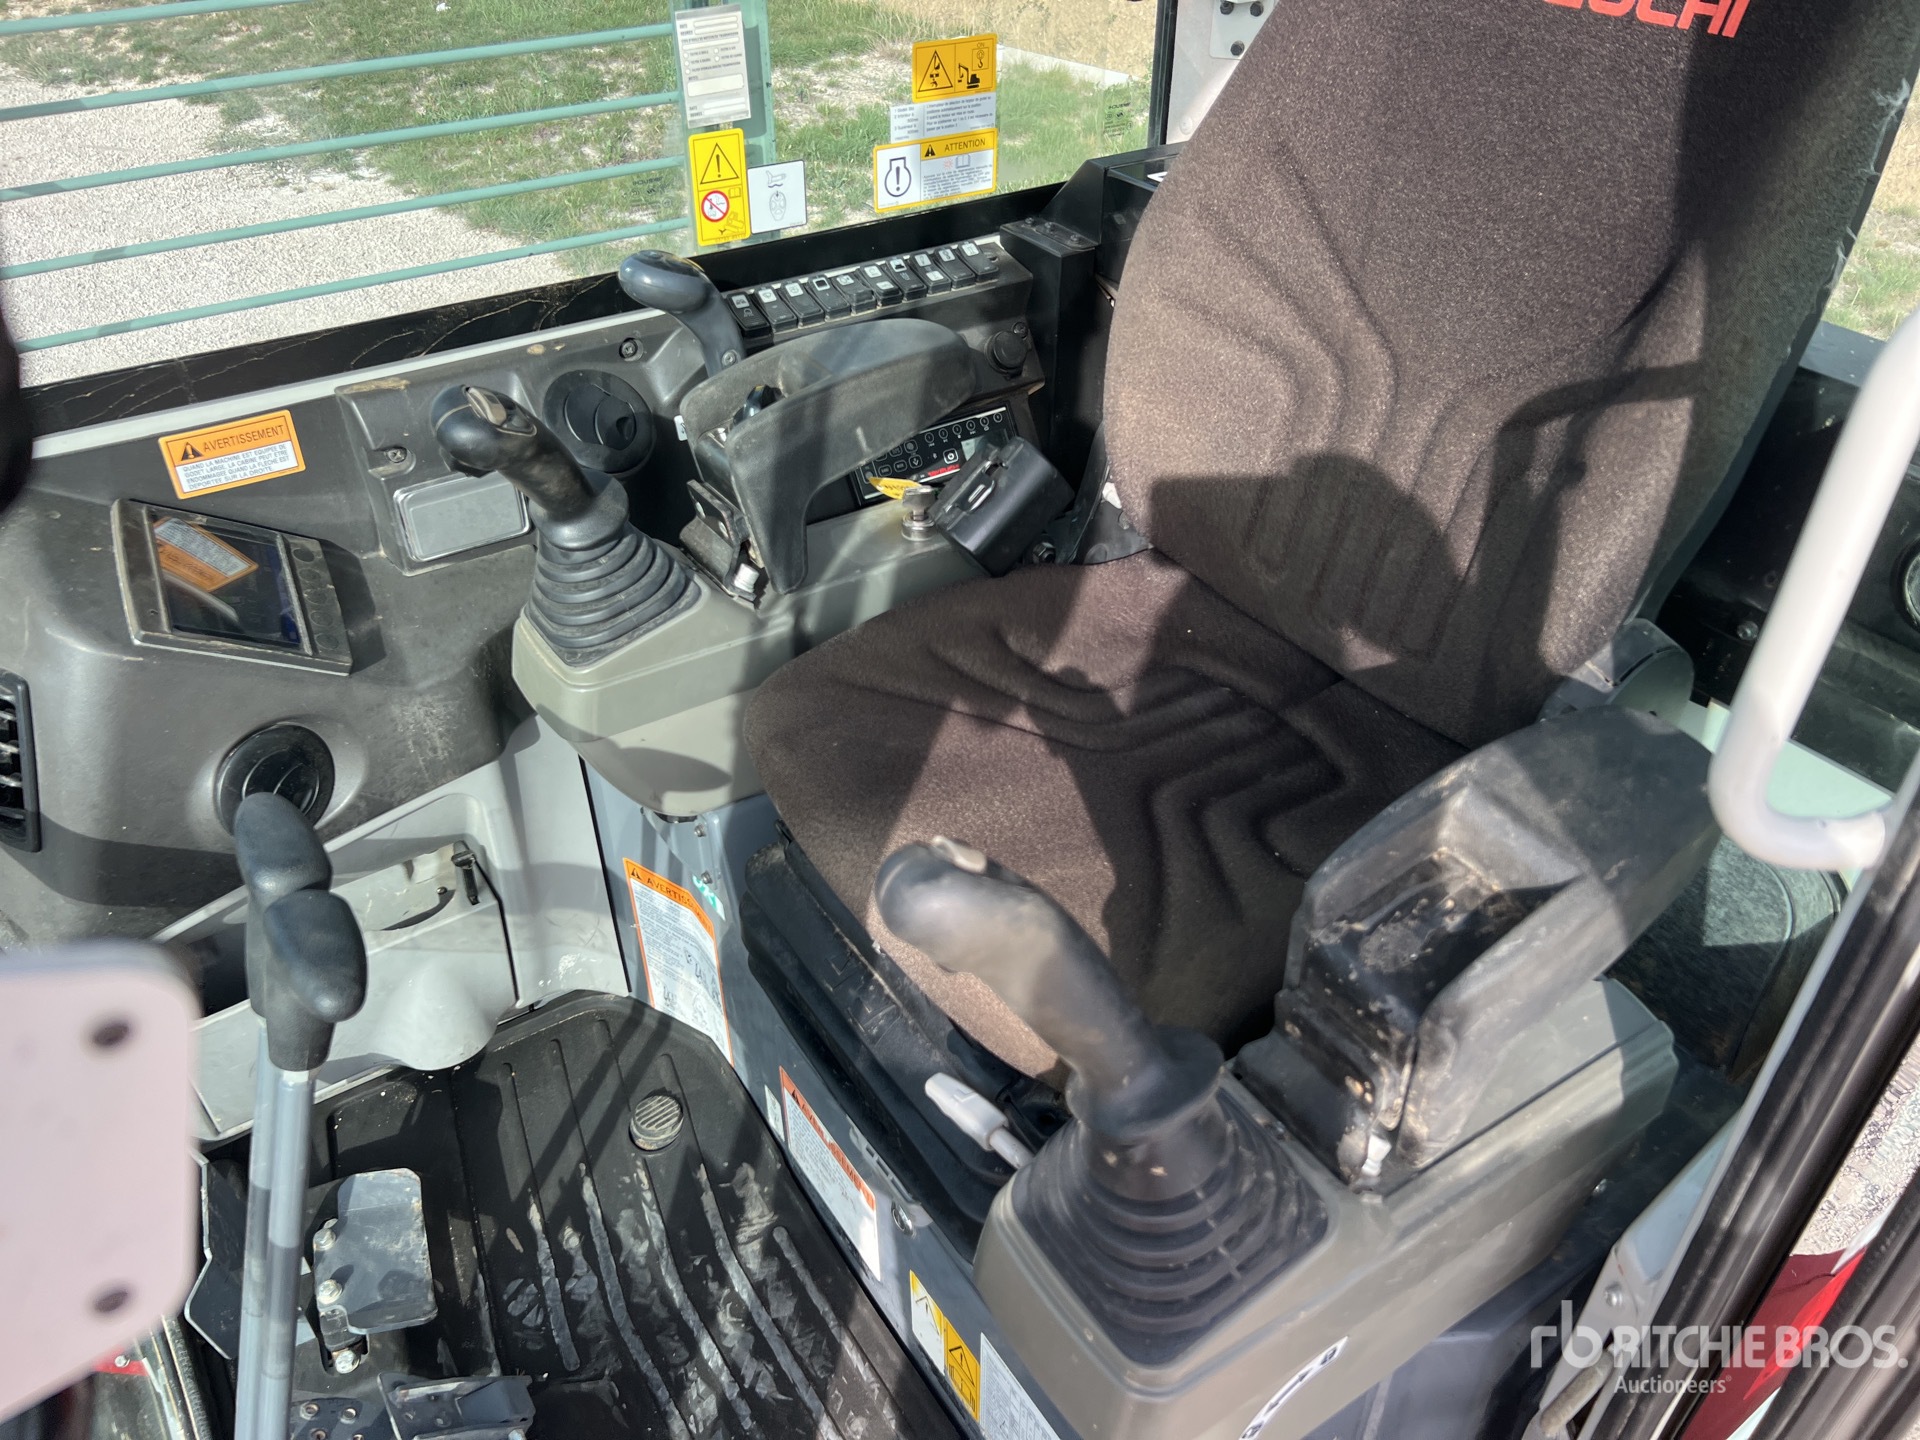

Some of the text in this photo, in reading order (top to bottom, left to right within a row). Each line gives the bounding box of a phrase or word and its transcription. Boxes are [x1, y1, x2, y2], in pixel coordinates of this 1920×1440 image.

[944, 138, 986, 152] ATTENTION
[203, 425, 284, 453] AVERTISSEMENT
[204, 459, 214, 467] LA
[214, 453, 241, 465] MACHINE
[223, 473, 238, 482] SUR
